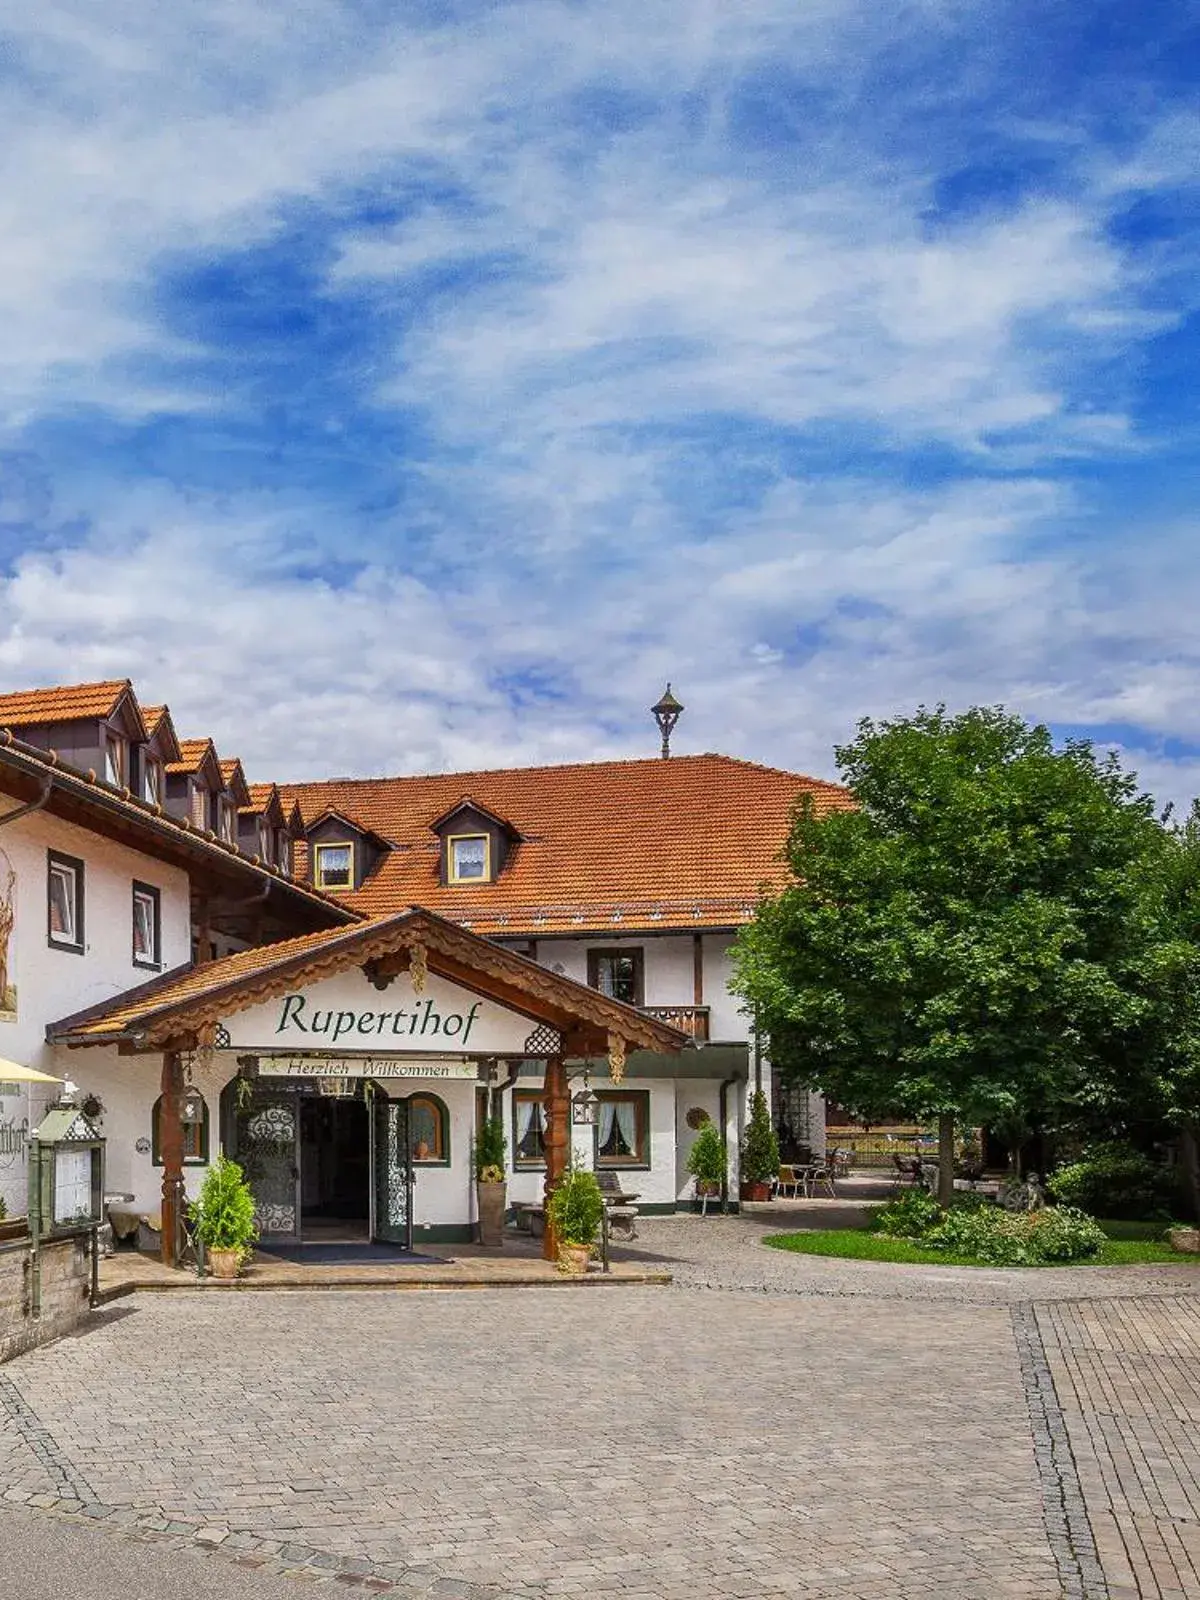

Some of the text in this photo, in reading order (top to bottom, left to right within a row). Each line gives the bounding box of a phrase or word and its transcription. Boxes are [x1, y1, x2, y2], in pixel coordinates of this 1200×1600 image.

[275, 994, 483, 1045] Rupertihof
[287, 1059, 450, 1077] Herzlich Willkommen
